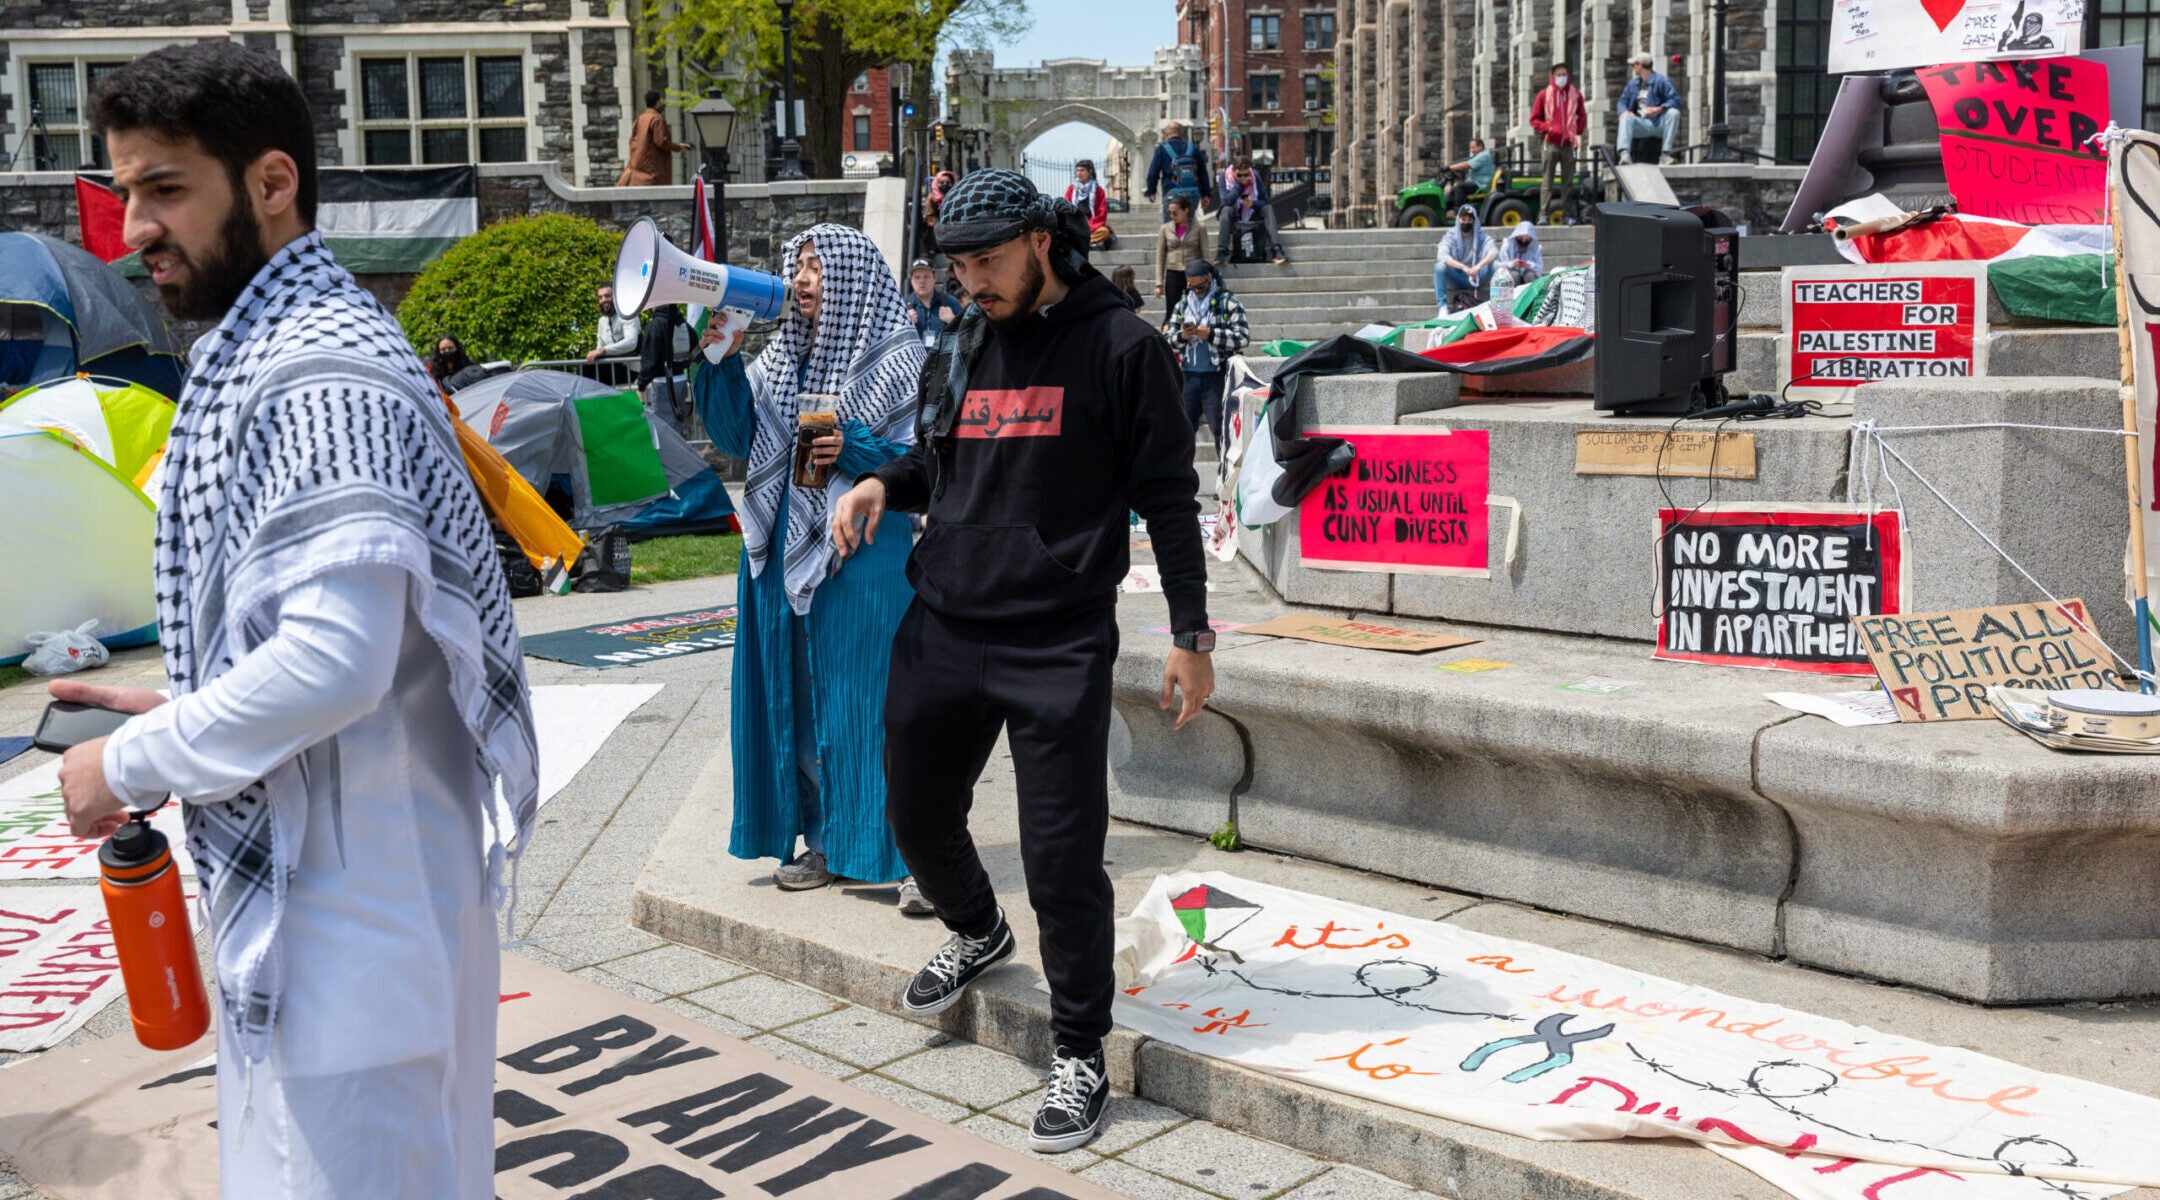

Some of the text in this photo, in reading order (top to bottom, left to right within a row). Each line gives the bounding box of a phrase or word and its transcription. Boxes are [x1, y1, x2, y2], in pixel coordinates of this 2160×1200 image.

[1964, 14, 1998, 30] FREE
[1926, 60, 2075, 102] TAKE
[1953, 97, 2101, 156] OVER
[1796, 282, 1921, 303] TEACHERS
[1903, 304, 1956, 325] FOR
[1798, 332, 1934, 352] PALESTINE
[1810, 360, 1968, 379] LIBERATION
[960, 397, 1054, 437] سمرقن
[1585, 433, 1657, 446] SOLIDARITY
[1625, 445, 1649, 454] STOP
[1323, 484, 1349, 512] AS
[1356, 490, 1414, 515] USUAL
[1323, 513, 1381, 544] CUNY
[1674, 533, 1850, 570] NO MORE
[1671, 568, 1876, 617] INVESTMENT
[1669, 614, 1701, 651] IN
[1861, 608, 2073, 653] FREE ALL
[1889, 639, 2098, 685] POLITICAL
[1273, 921, 2041, 1119] it's a wonderful
[496, 1014, 720, 1097] BY
[617, 1072, 933, 1197] ANY
